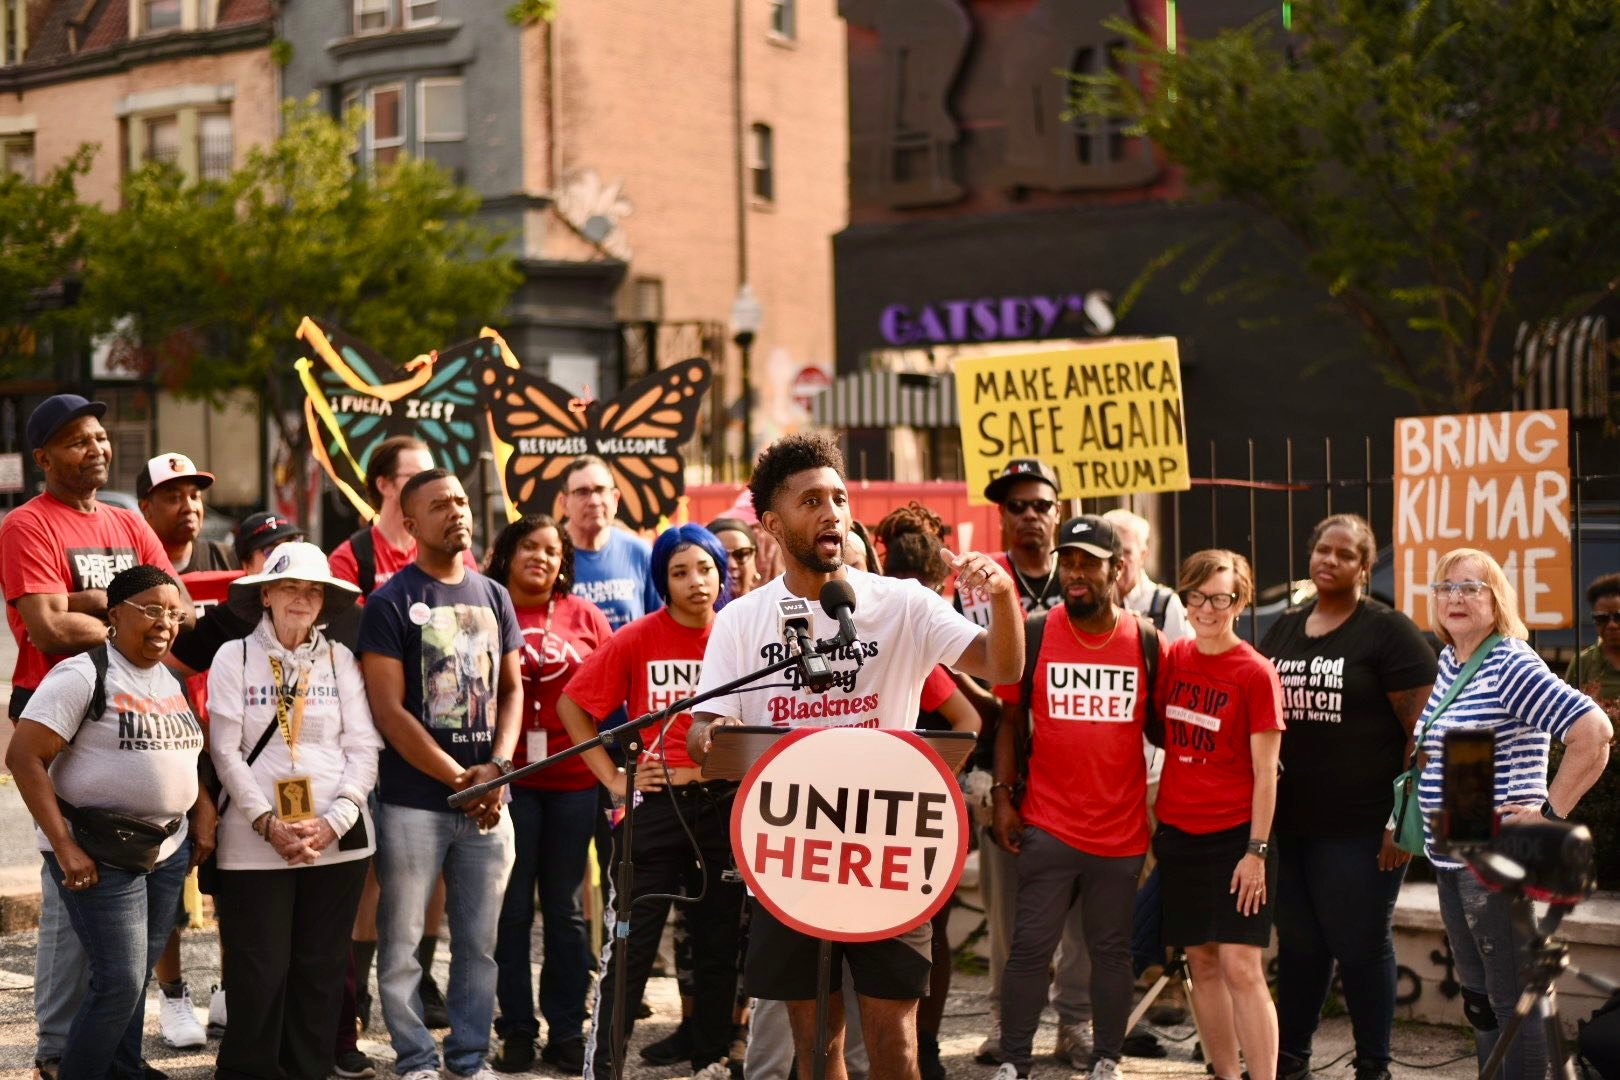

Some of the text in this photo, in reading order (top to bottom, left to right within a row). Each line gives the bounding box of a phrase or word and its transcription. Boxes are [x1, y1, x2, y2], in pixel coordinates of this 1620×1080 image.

[880, 289, 1116, 345] GATSBY'S
[974, 360, 1178, 404] MAKE AMERICA
[978, 398, 1183, 457] SAFE AGAIN
[519, 437, 667, 455] REFUGEES WELCOME
[1400, 411, 1559, 476] BRING
[1073, 457, 1178, 489] TRUMP
[1399, 470, 1571, 544] KILMAR
[74, 553, 133, 574] DEFEAT
[79, 570, 115, 589] TRU
[1402, 547, 1563, 625] HE
[784, 603, 804, 611] WJZ
[651, 664, 702, 686] UNI
[1310, 656, 1345, 676] God
[784, 666, 858, 693] Tay
[1051, 667, 1135, 692] UNITE
[1309, 673, 1321, 687] of
[767, 693, 879, 722] Blackness
[1051, 694, 1131, 718] HERE!
[1169, 681, 1229, 716] IT'S UP
[1282, 687, 1342, 712] ildren
[1292, 709, 1305, 720] MY
[1308, 710, 1342, 723] Nerves
[452, 731, 491, 743] Est. 1925
[1191, 726, 1216, 752] US
[759, 781, 947, 839] UNITE
[754, 832, 938, 895] HERE!
